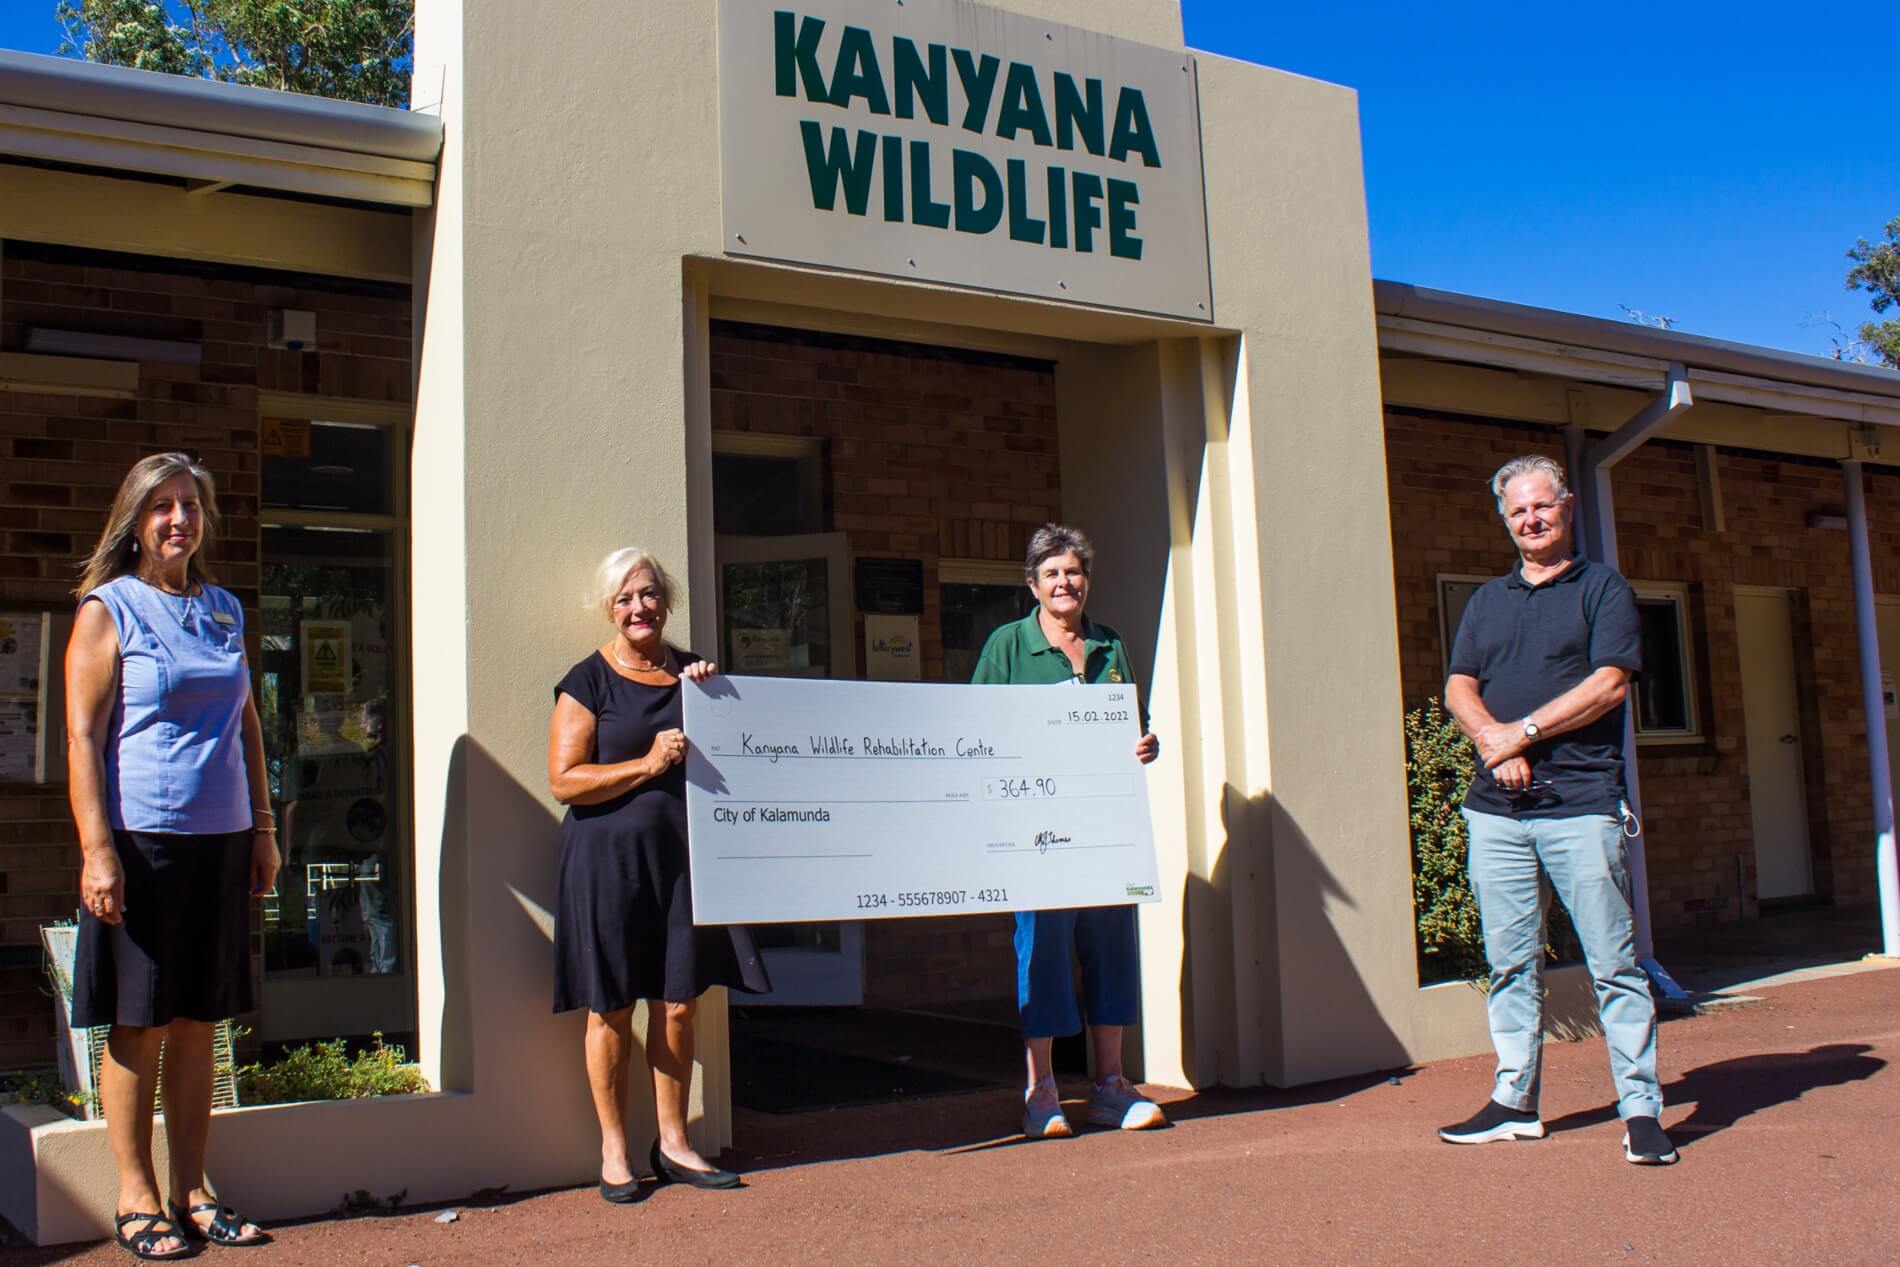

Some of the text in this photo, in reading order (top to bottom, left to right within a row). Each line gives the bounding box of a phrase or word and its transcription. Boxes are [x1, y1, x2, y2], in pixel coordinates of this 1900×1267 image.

[774, 10, 1162, 168] KANYANA
[800, 120, 1143, 260] WILDLIFE
[1108, 693, 1125, 702] 1234
[742, 733, 995, 763] Kanyana Wildlife Rehabilitation Centre
[1000, 777, 1056, 798] 364.90
[713, 807, 830, 825] City of Kalamunda
[857, 894, 887, 908] 1234
[898, 890, 966, 906] 555678907
[978, 888, 1008, 903] 4321
